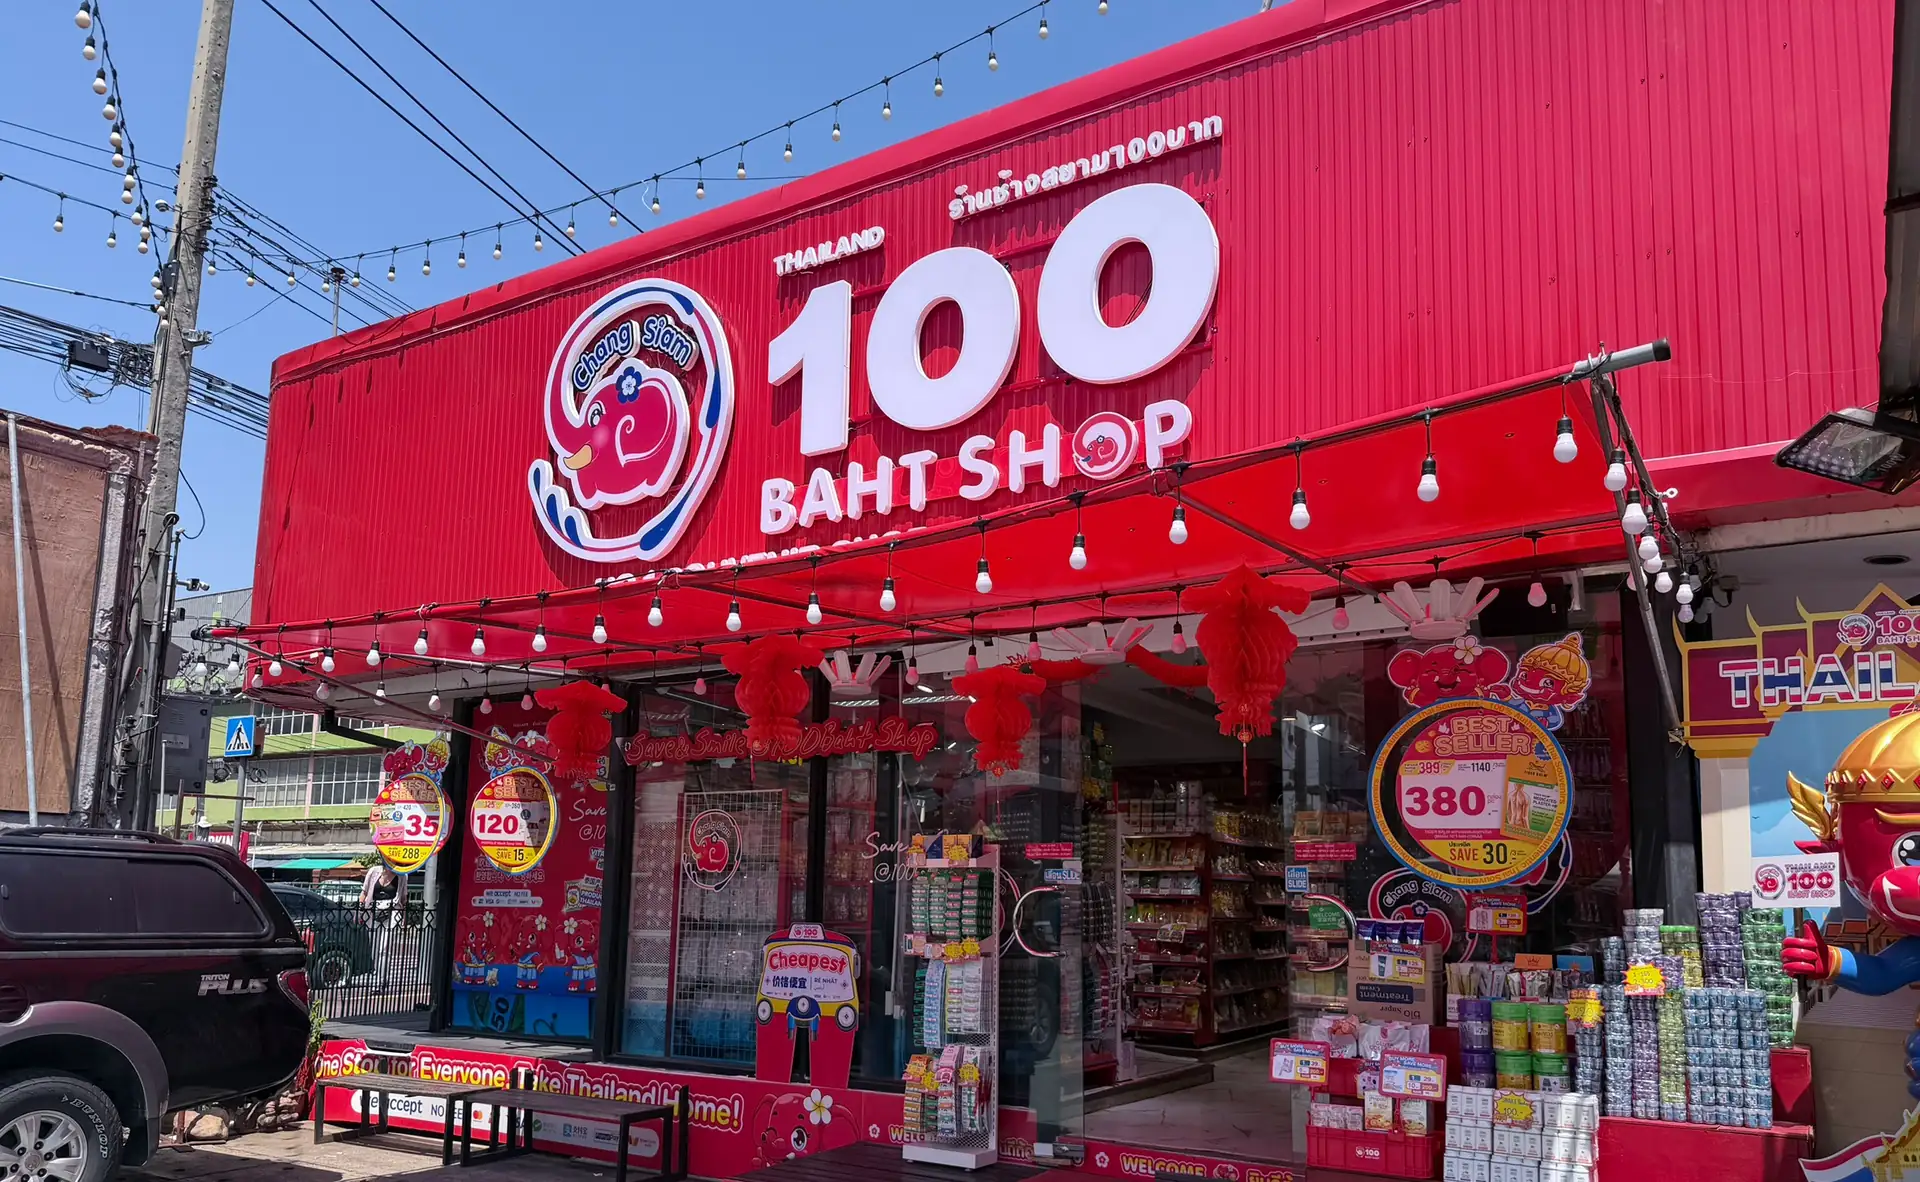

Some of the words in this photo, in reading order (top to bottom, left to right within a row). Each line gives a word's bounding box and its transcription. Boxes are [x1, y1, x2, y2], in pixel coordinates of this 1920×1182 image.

[773, 225, 885, 276] THAILAND
[768, 183, 1219, 457] 100
[573, 320, 636, 390] Chang
[641, 315, 695, 367] Siam
[761, 448, 937, 534] BAHT
[1451, 716, 1513, 734] BEST
[1434, 734, 1532, 755] SELLER
[1418, 761, 1440, 774] 399
[400, 780, 428, 791] BEST
[503, 775, 534, 787] BEST
[390, 790, 438, 802] SELLER
[1405, 785, 1486, 816] 380
[569, 799, 607, 821] Save
[405, 814, 440, 837] 35
[477, 814, 518, 834] 120
[862, 831, 909, 859] Save
[402, 848, 420, 859] 288
[496, 851, 511, 859] SAVE
[1449, 848, 1479, 861] SAVE
[1784, 861, 1836, 873] THAILAND
[1287, 880, 1307, 888] SLIDE
[1787, 872, 1834, 890] 100
[1382, 880, 1419, 908] Chang
[1421, 880, 1454, 905] Siam
[1311, 910, 1341, 918] WELCOME
[803, 928, 818, 936] 100
[768, 951, 847, 975] Cheapest
[200, 973, 230, 981] TRITON
[772, 975, 807, 989] 价格便宜
[197, 978, 269, 997] PLUS
[1359, 990, 1411, 1002] Treatment
[1379, 1005, 1402, 1014] Super
[315, 1056, 339, 1078] One
[430, 1103, 445, 1117] NO
[70, 1098, 108, 1158] DUNLOP
[1364, 1148, 1380, 1157] 100
